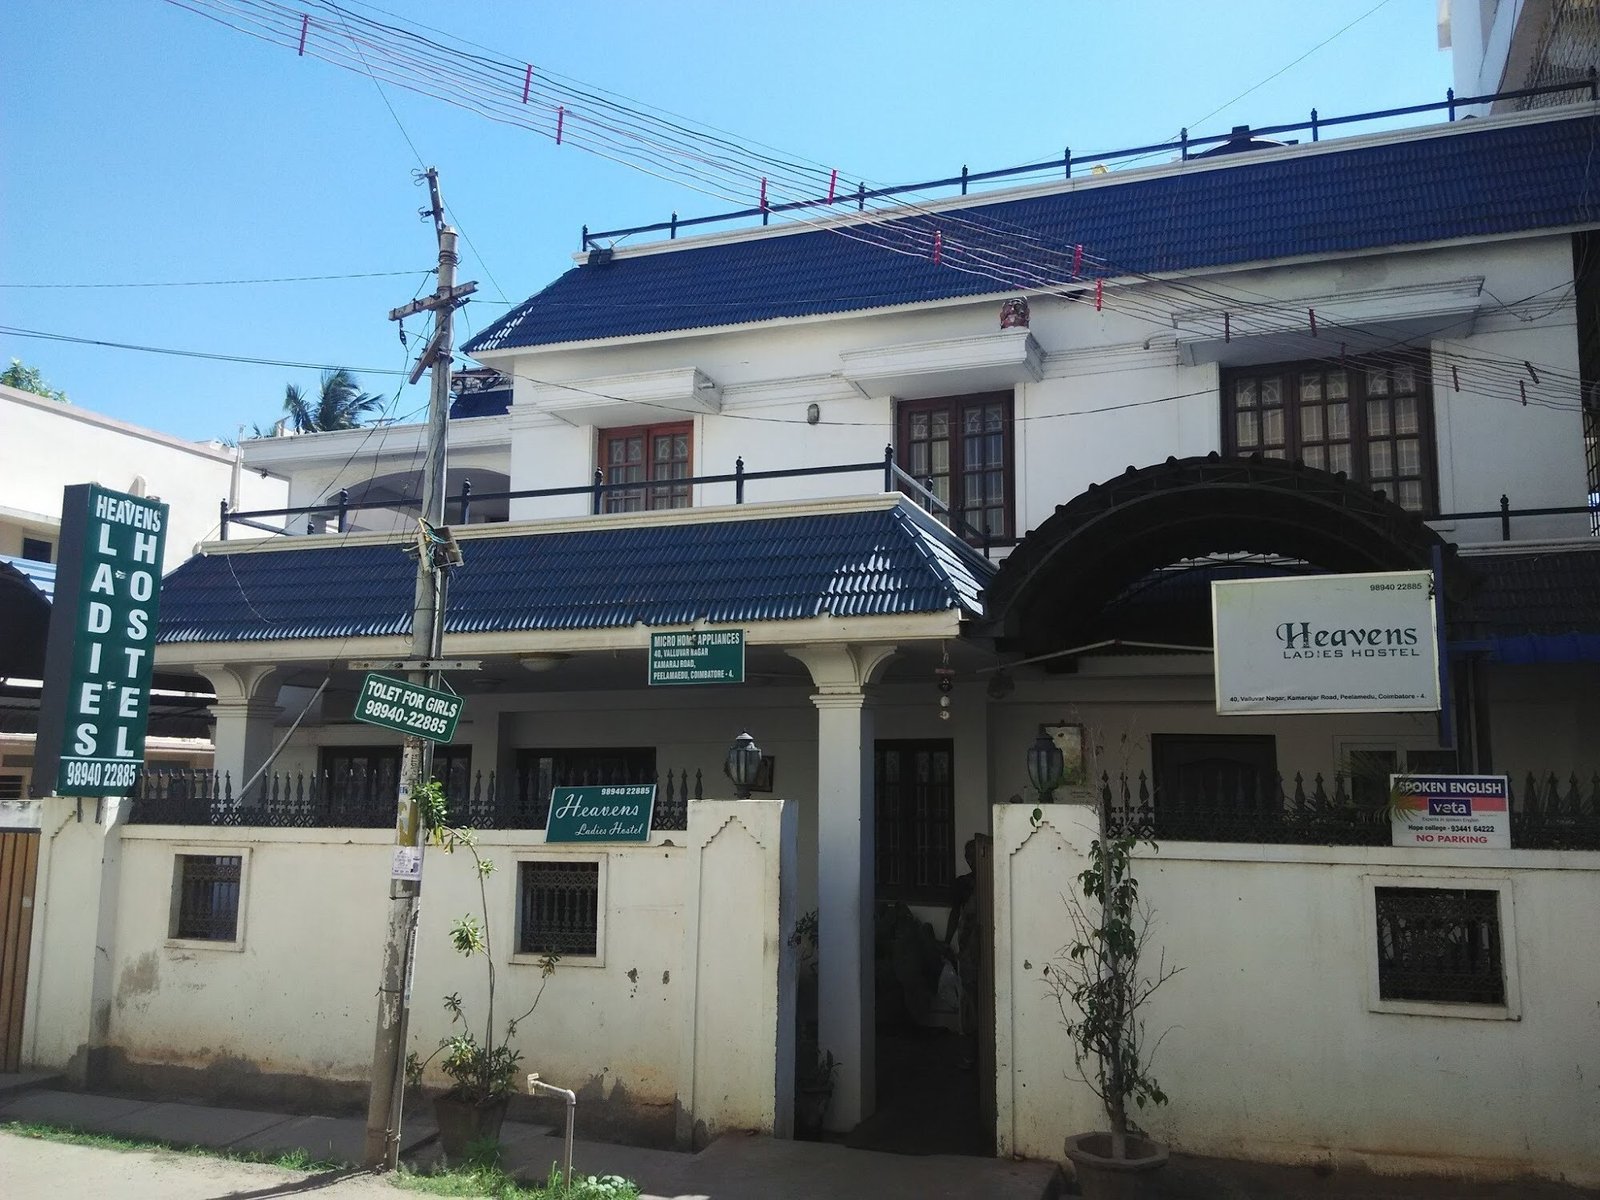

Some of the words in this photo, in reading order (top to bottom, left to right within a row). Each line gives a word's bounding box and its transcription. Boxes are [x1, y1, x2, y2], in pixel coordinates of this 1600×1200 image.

[96, 494, 161, 532] HEAVENS
[1370, 583, 1395, 592] 98940
[1396, 583, 1422, 591] 22885
[75, 524, 117, 756] LADIES
[116, 532, 157, 758] HOSTEL
[654, 635, 676, 647] MICRO
[698, 632, 740, 645] APPLIANCES
[1276, 622, 1418, 649] Heavens
[1283, 649, 1344, 659] LADIES
[1352, 648, 1420, 658] HOSTEL
[367, 681, 402, 702] TOLET
[402, 690, 425, 709] FOR
[425, 697, 458, 718] GIRLS
[365, 700, 448, 734] 98940-22885
[67, 761, 101, 786] 98940
[104, 763, 136, 787] 22885
[626, 787, 650, 795] 22885
[1450, 783, 1502, 794] ENGLISH
[555, 794, 639, 819] Heavens
[1433, 801, 1467, 814] veta
[575, 823, 607, 835] Ladies
[609, 821, 644, 835] Hostel
[1438, 835, 1488, 843] PARKING
